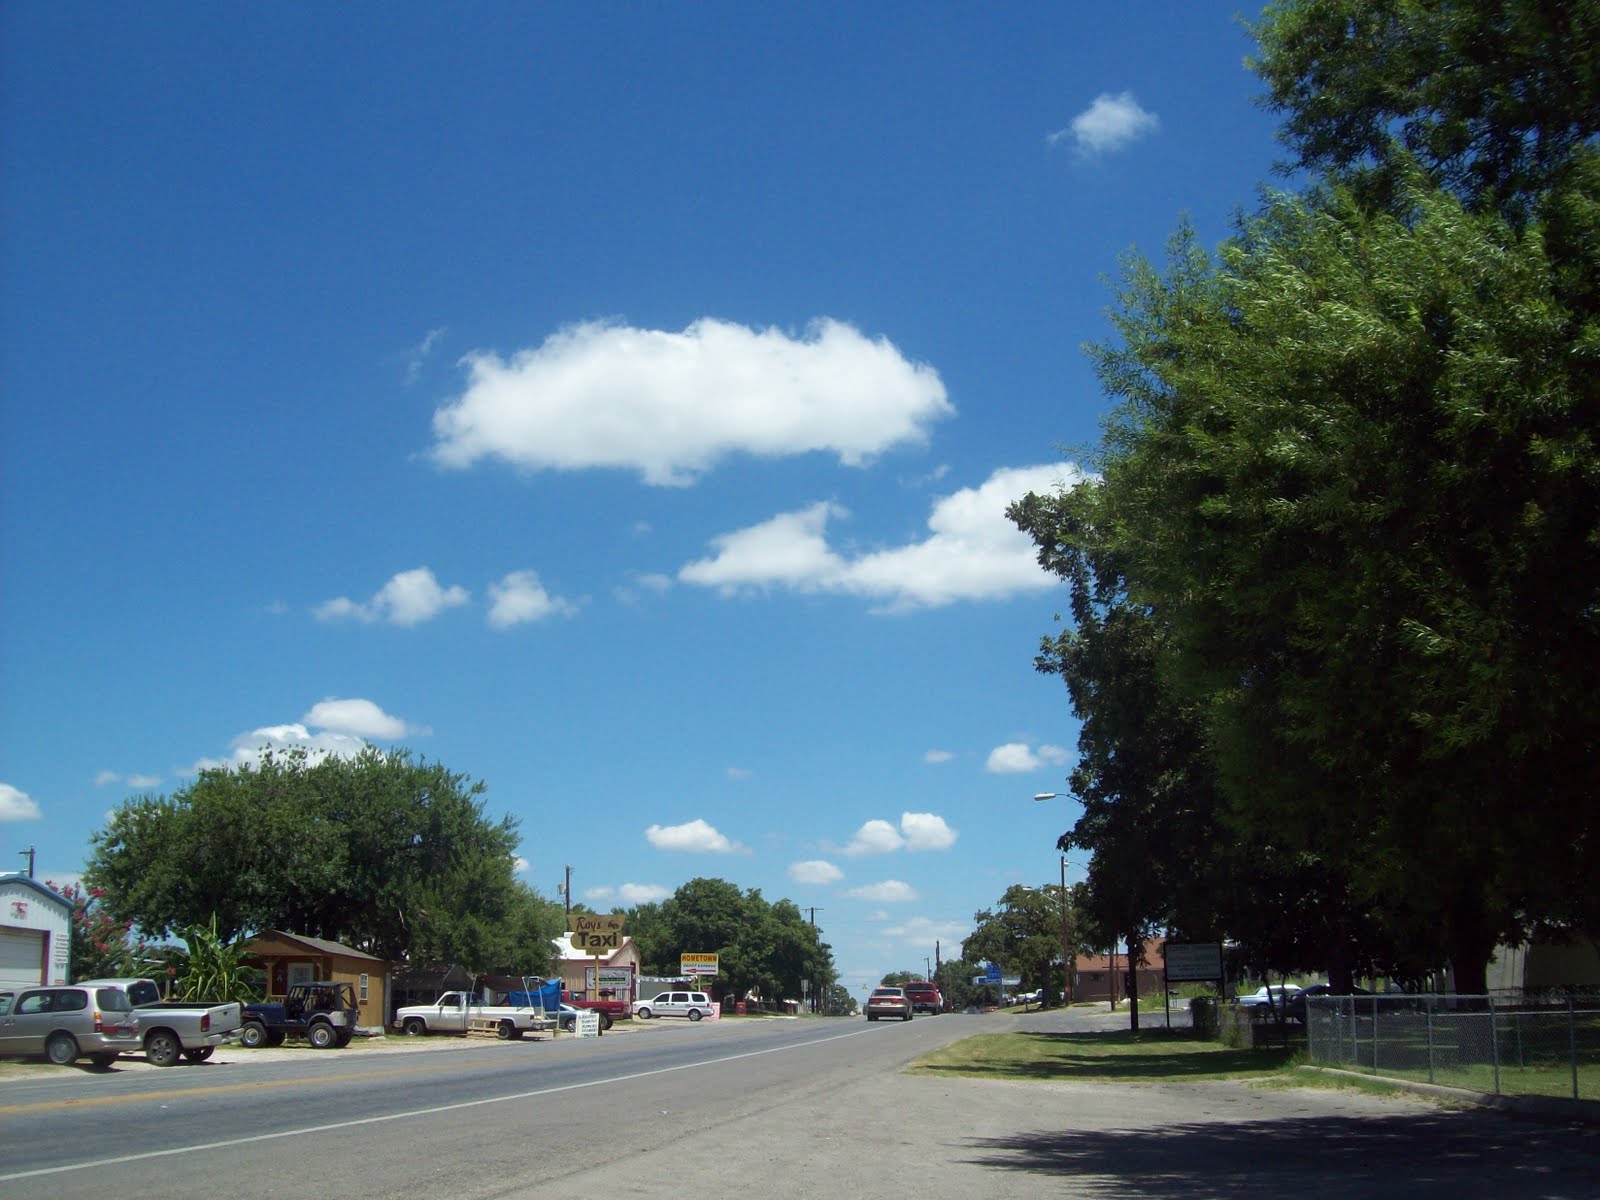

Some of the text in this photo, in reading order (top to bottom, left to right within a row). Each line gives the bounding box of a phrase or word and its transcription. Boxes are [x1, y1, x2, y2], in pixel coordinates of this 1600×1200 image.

[576, 917, 601, 932] Ray's
[578, 932, 617, 947] Taxi
[682, 954, 717, 962] HOMETOWN
